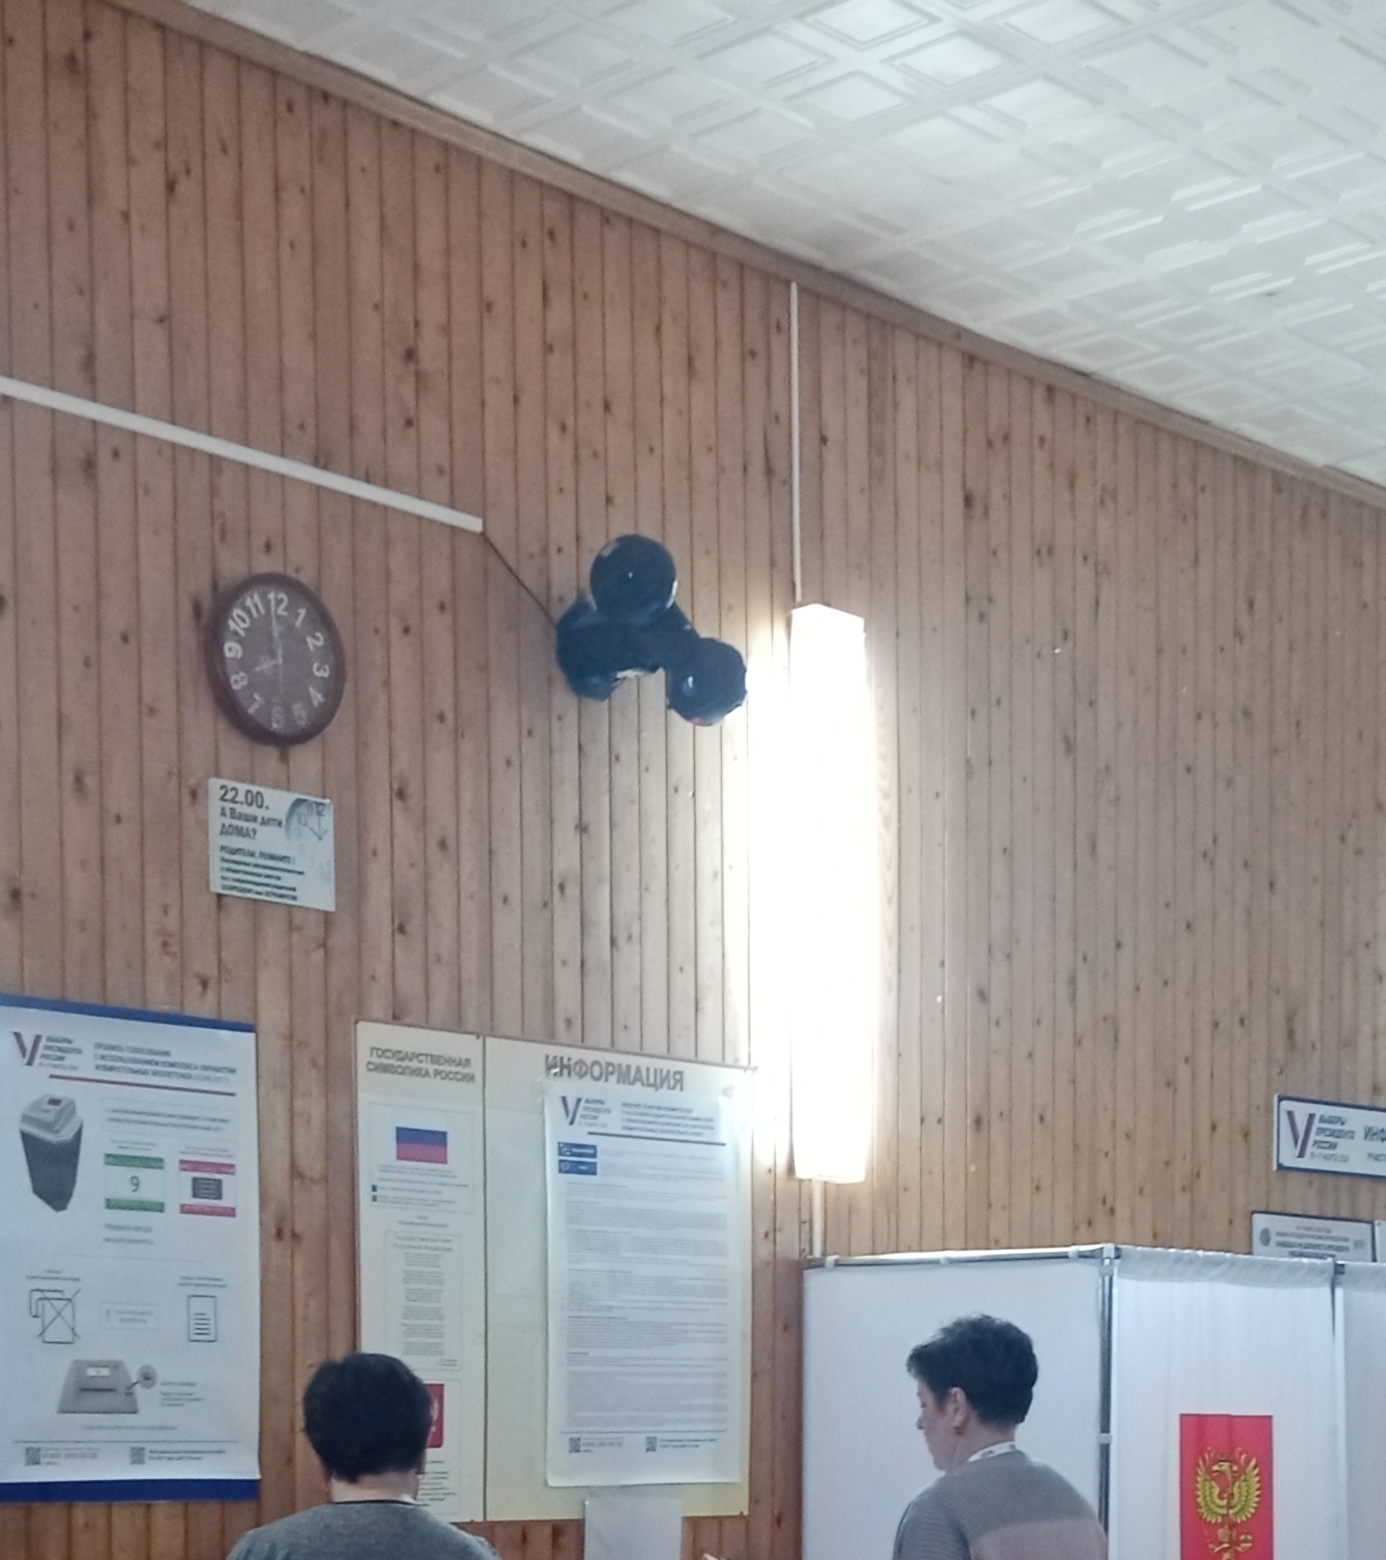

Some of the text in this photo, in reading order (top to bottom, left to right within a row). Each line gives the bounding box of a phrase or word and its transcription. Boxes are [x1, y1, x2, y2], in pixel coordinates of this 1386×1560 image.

[245, 591, 265, 619] 11
[267, 591, 289, 616] 12
[228, 608, 251, 637] 10
[295, 608, 307, 627] 1
[223, 641, 243, 659] 9
[306, 631, 324, 651] 2
[230, 671, 248, 690] 8
[313, 662, 330, 678] 3
[247, 692, 264, 714] 7
[309, 686, 324, 707] 4
[219, 785, 269, 810] 22.00.
[220, 823, 257, 839] ДОМА?
[370, 1046, 471, 1068] ГОСУДАРСТВЕННАЯ
[366, 1061, 475, 1083] СИМВОЛИКА РОССИИ
[545, 1054, 684, 1092] ИНФОРМАЦИЯ
